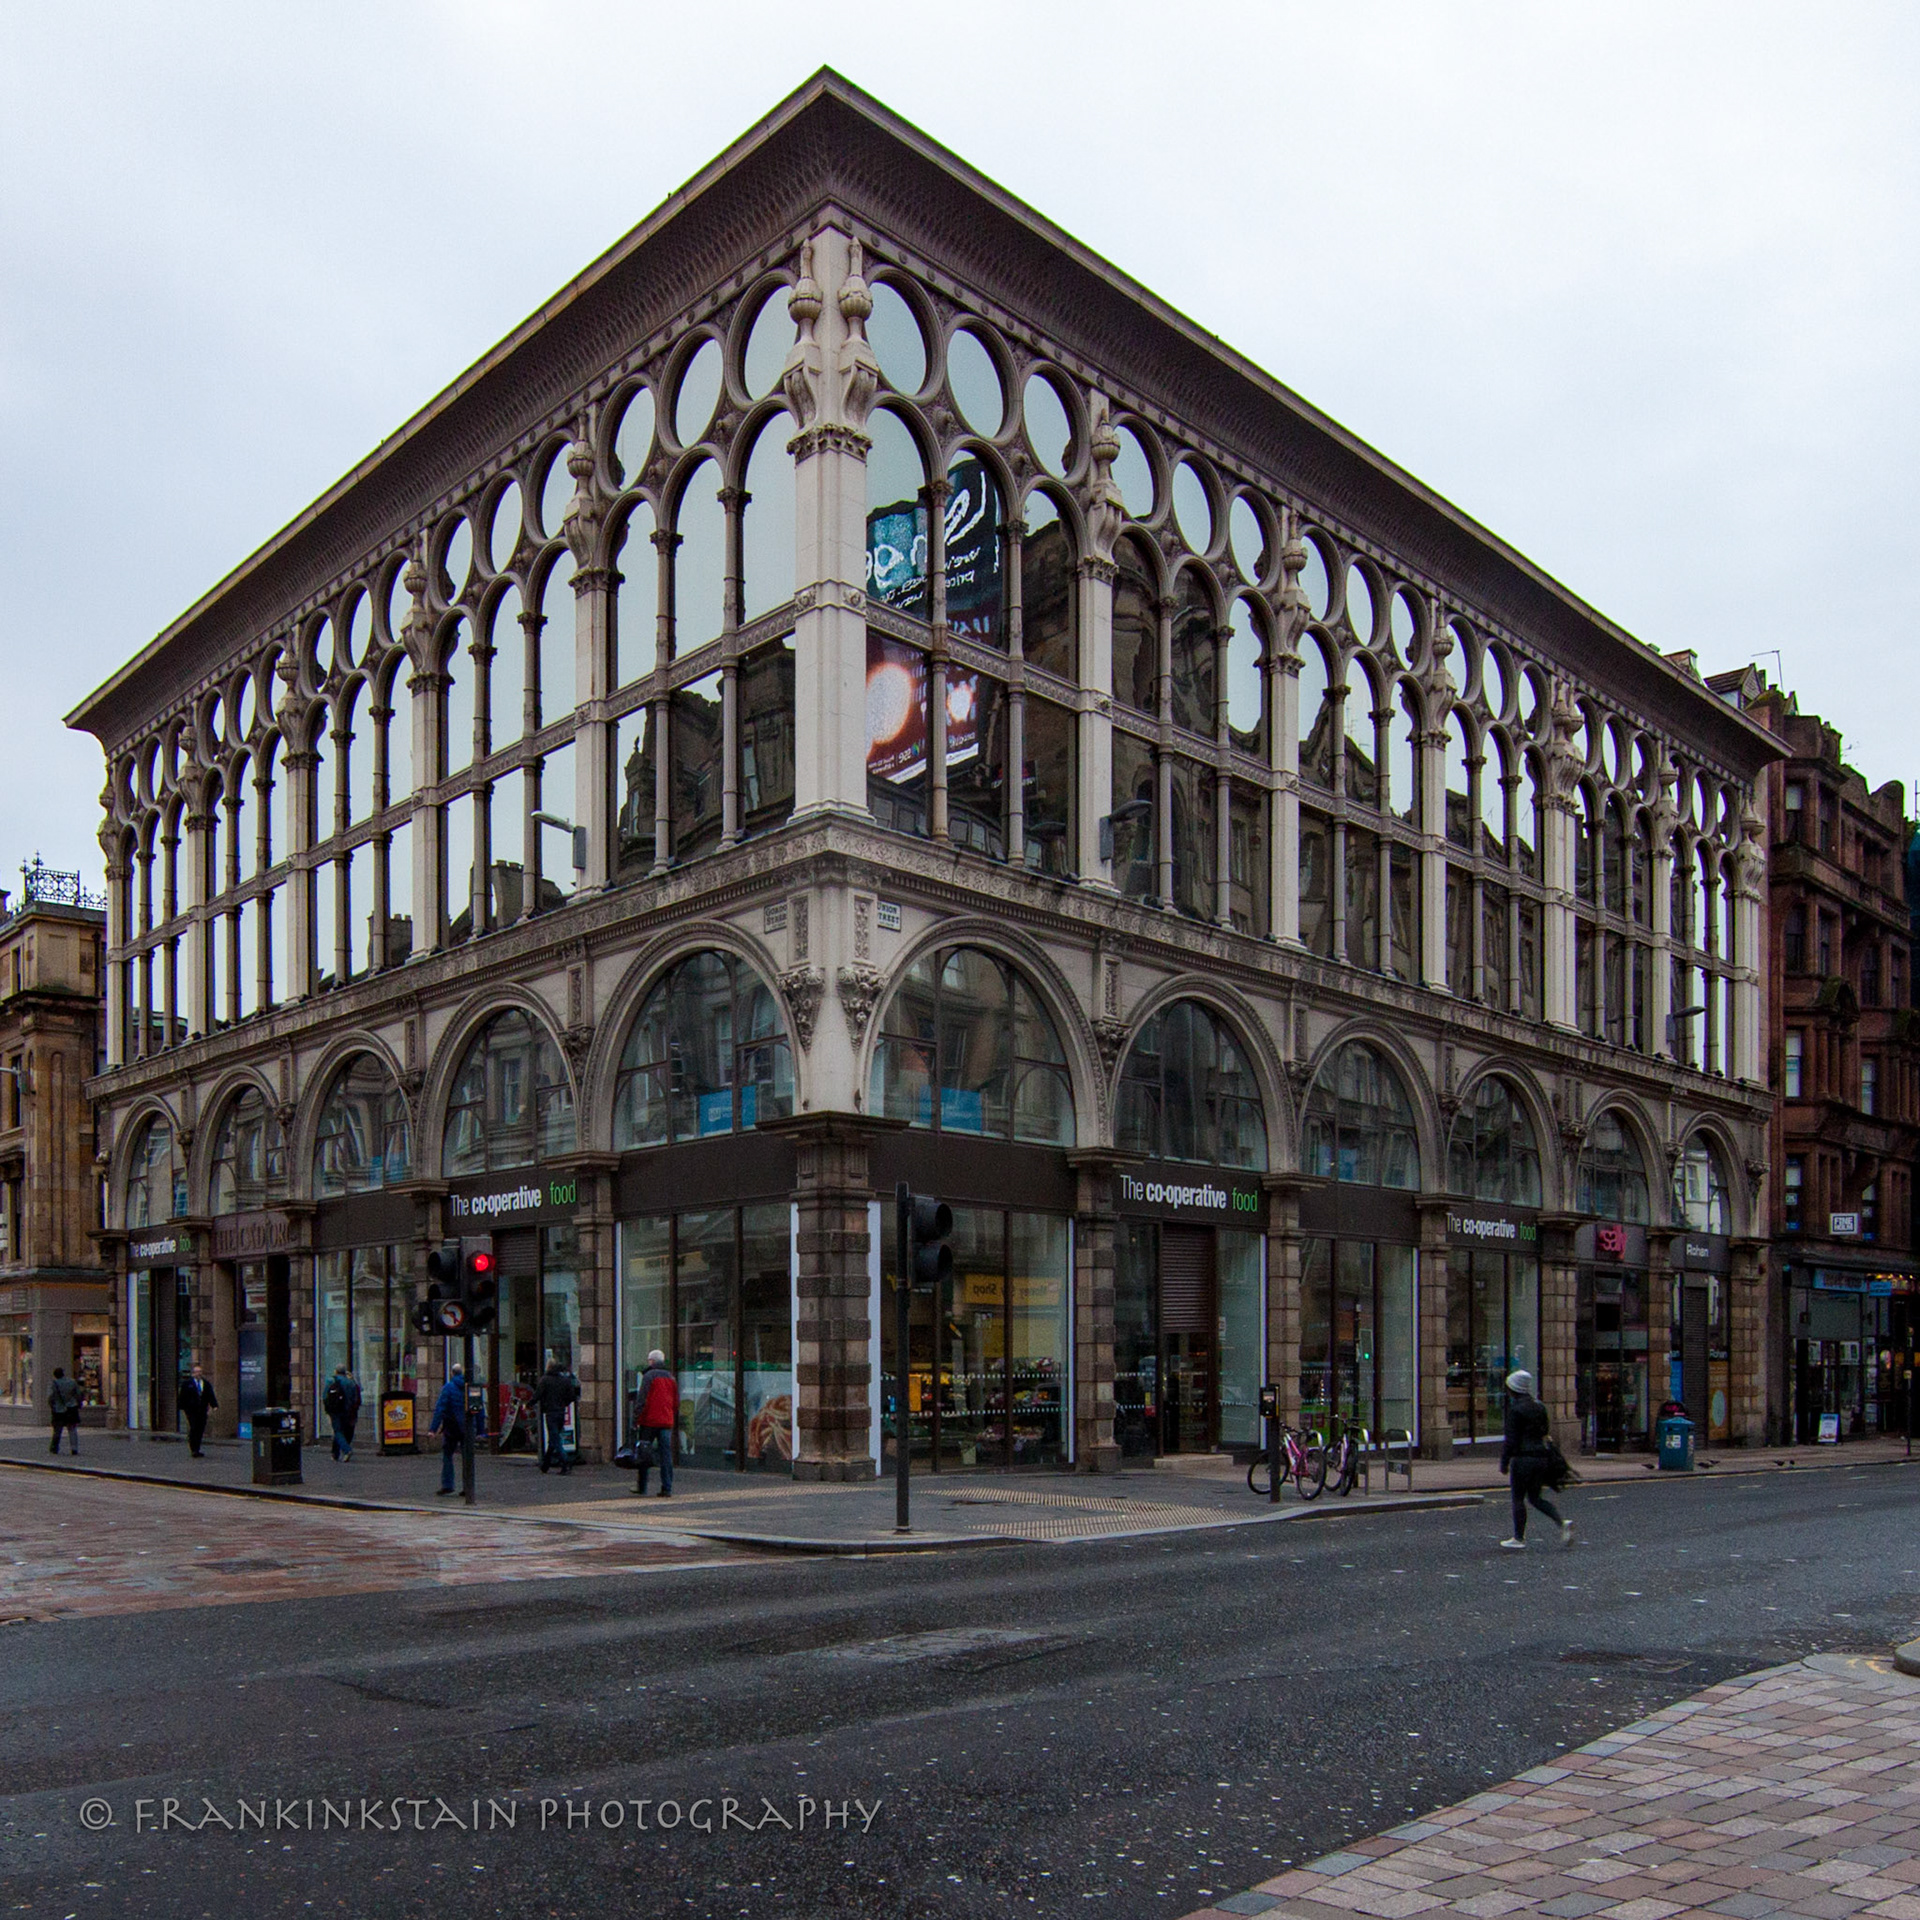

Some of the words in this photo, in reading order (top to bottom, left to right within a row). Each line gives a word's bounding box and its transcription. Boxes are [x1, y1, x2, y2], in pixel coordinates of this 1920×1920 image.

[765, 904, 787, 916] GORDO
[877, 902, 897, 914] UNION
[766, 913, 787, 926] STREE
[877, 912, 899, 924] TREET
[450, 1194, 469, 1217] The
[471, 1185, 542, 1217] co-operative
[549, 1179, 576, 1206] food
[1120, 1174, 1144, 1201] The
[1145, 1182, 1227, 1209] co-operative
[1232, 1187, 1258, 1212] food
[1446, 1212, 1461, 1233] The
[1462, 1218, 1516, 1239] co-operative
[1520, 1221, 1536, 1240] food
[140, 1236, 176, 1259] co-operative
[179, 1234, 192, 1252] foo
[1686, 1243, 1710, 1258] Rohan
